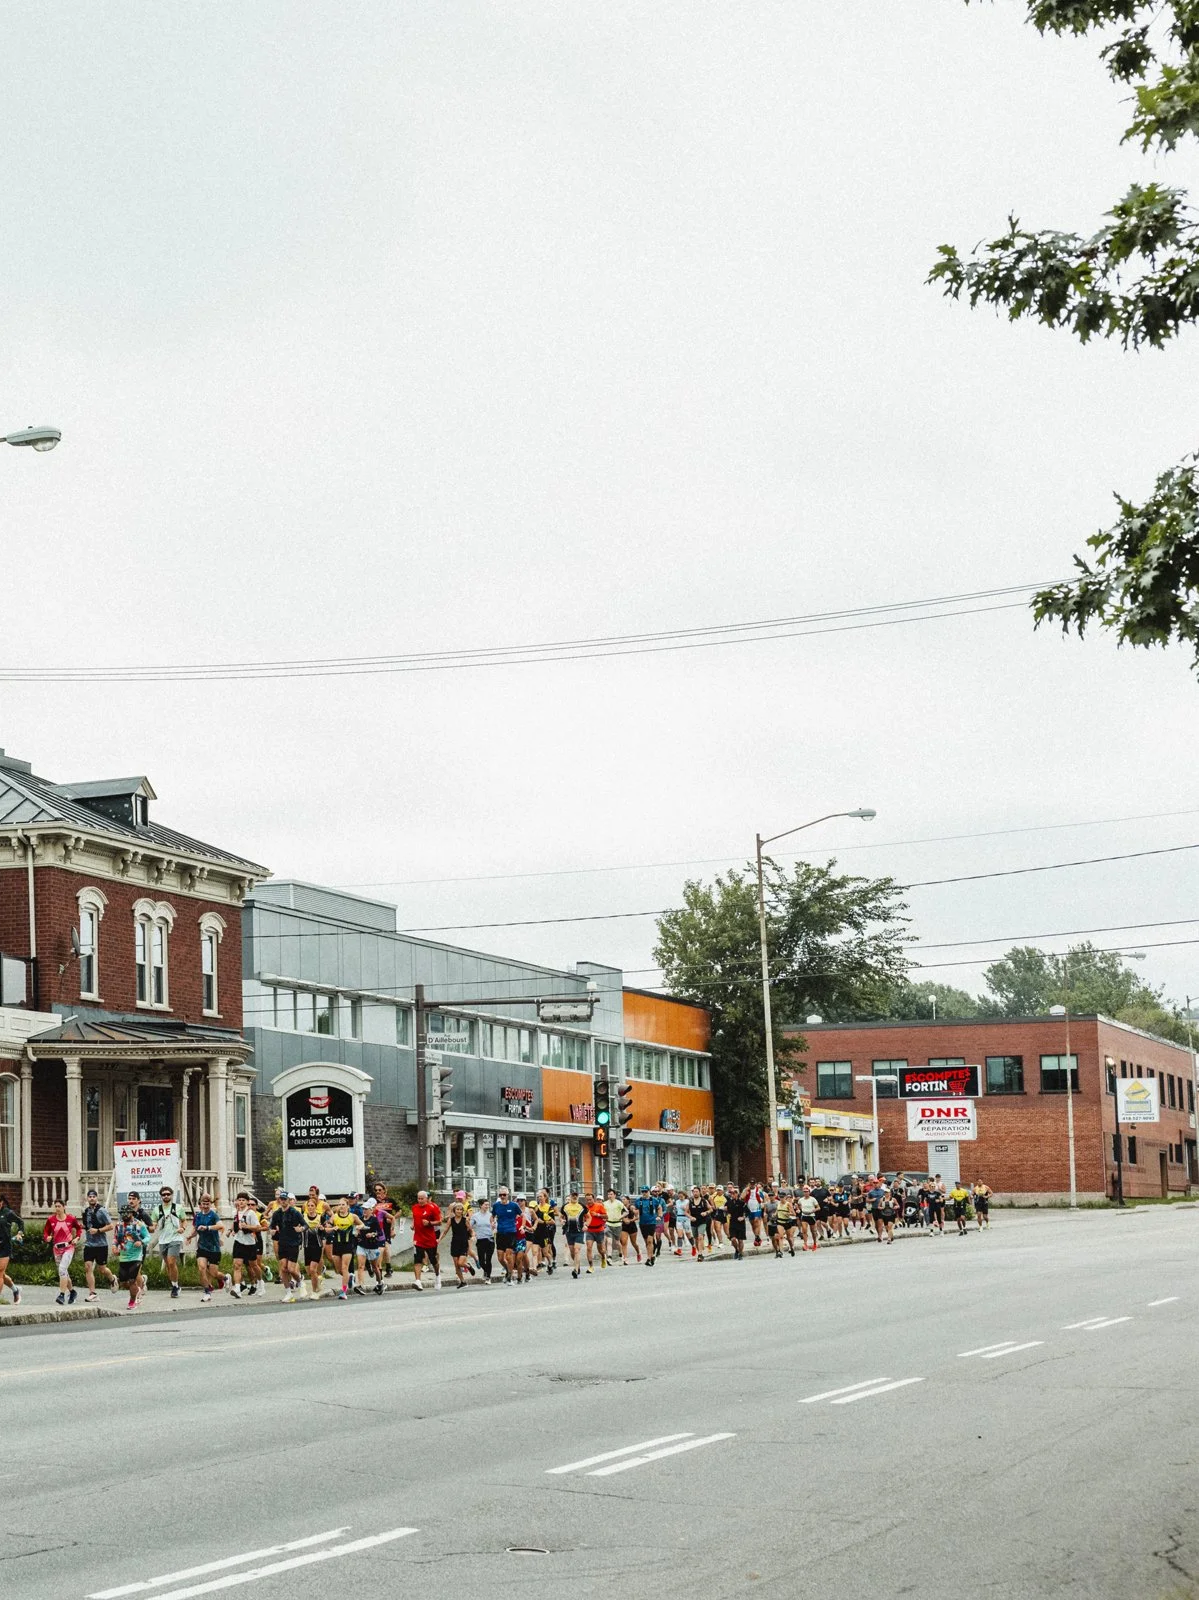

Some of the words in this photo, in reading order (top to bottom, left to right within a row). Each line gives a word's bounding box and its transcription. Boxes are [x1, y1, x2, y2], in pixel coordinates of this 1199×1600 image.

[905, 1080, 947, 1092] FORTIN
[921, 1108, 968, 1118] DNR
[291, 1117, 323, 1127] Sabrina
[325, 1116, 348, 1126] Sirois
[290, 1129, 307, 1137] 418
[310, 1127, 352, 1136] 527-6449
[121, 1148, 128, 1158] À
[131, 1147, 171, 1157] VENDRE
[131, 1167, 162, 1175] RE/MAX
